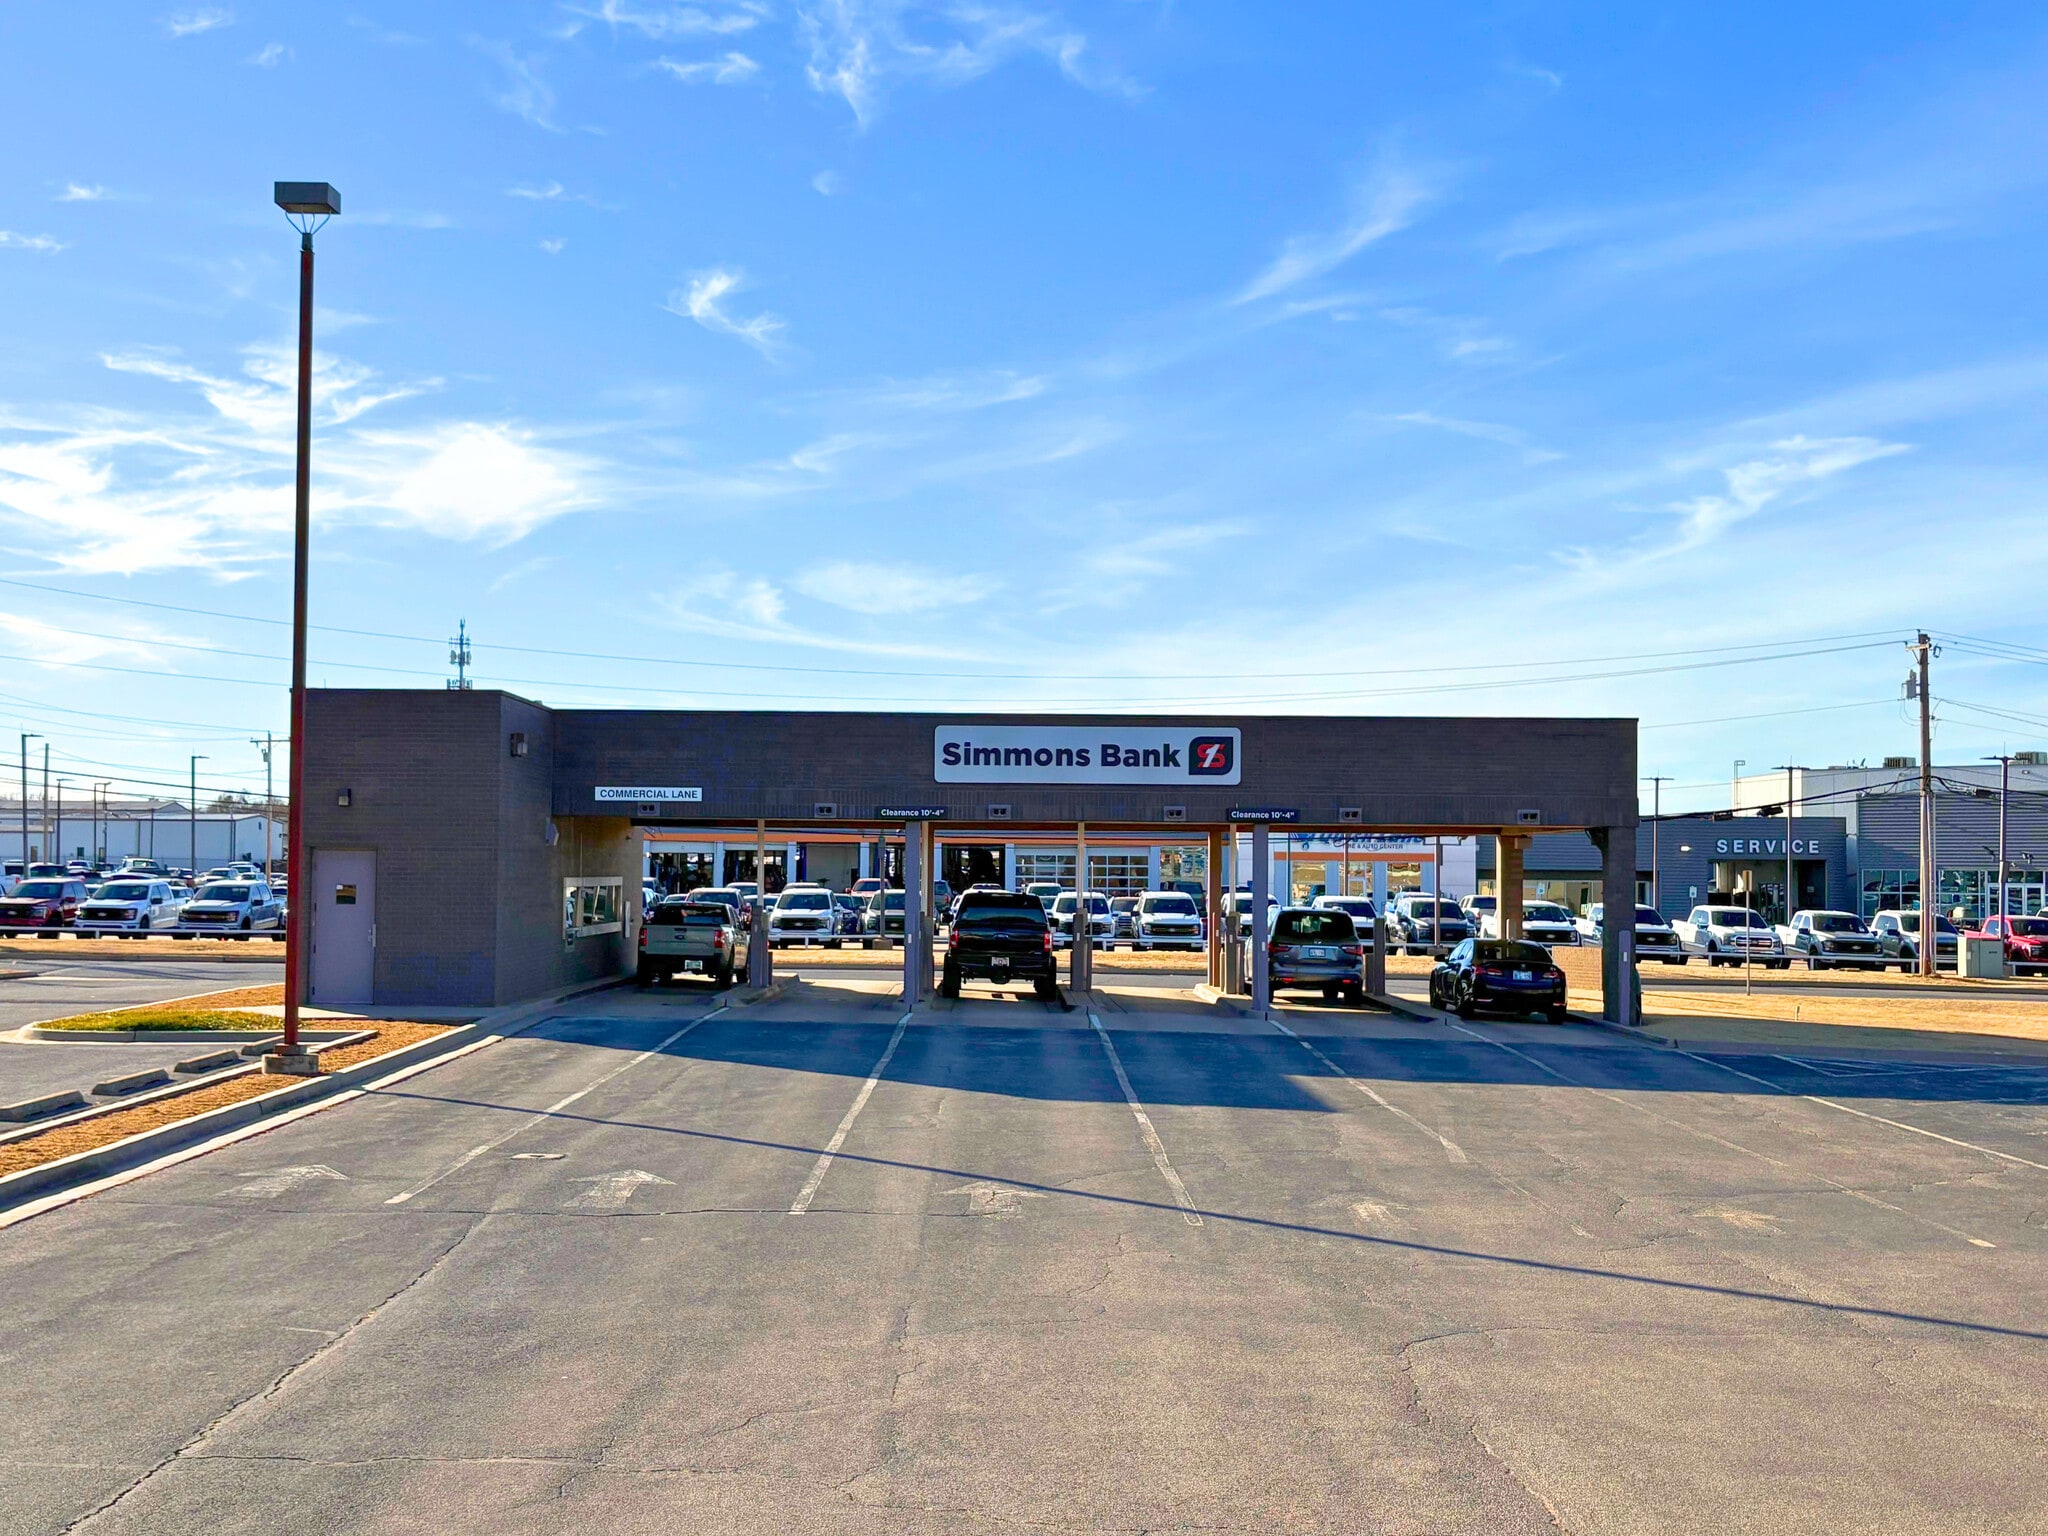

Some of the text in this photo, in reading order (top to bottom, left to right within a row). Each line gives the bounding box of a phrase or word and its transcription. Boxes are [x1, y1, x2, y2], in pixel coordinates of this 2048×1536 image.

[942, 741, 1181, 767] Simmons Bank
[600, 789, 698, 798] COMMERCIAL LANE
[1716, 839, 1819, 854] SERVICE
